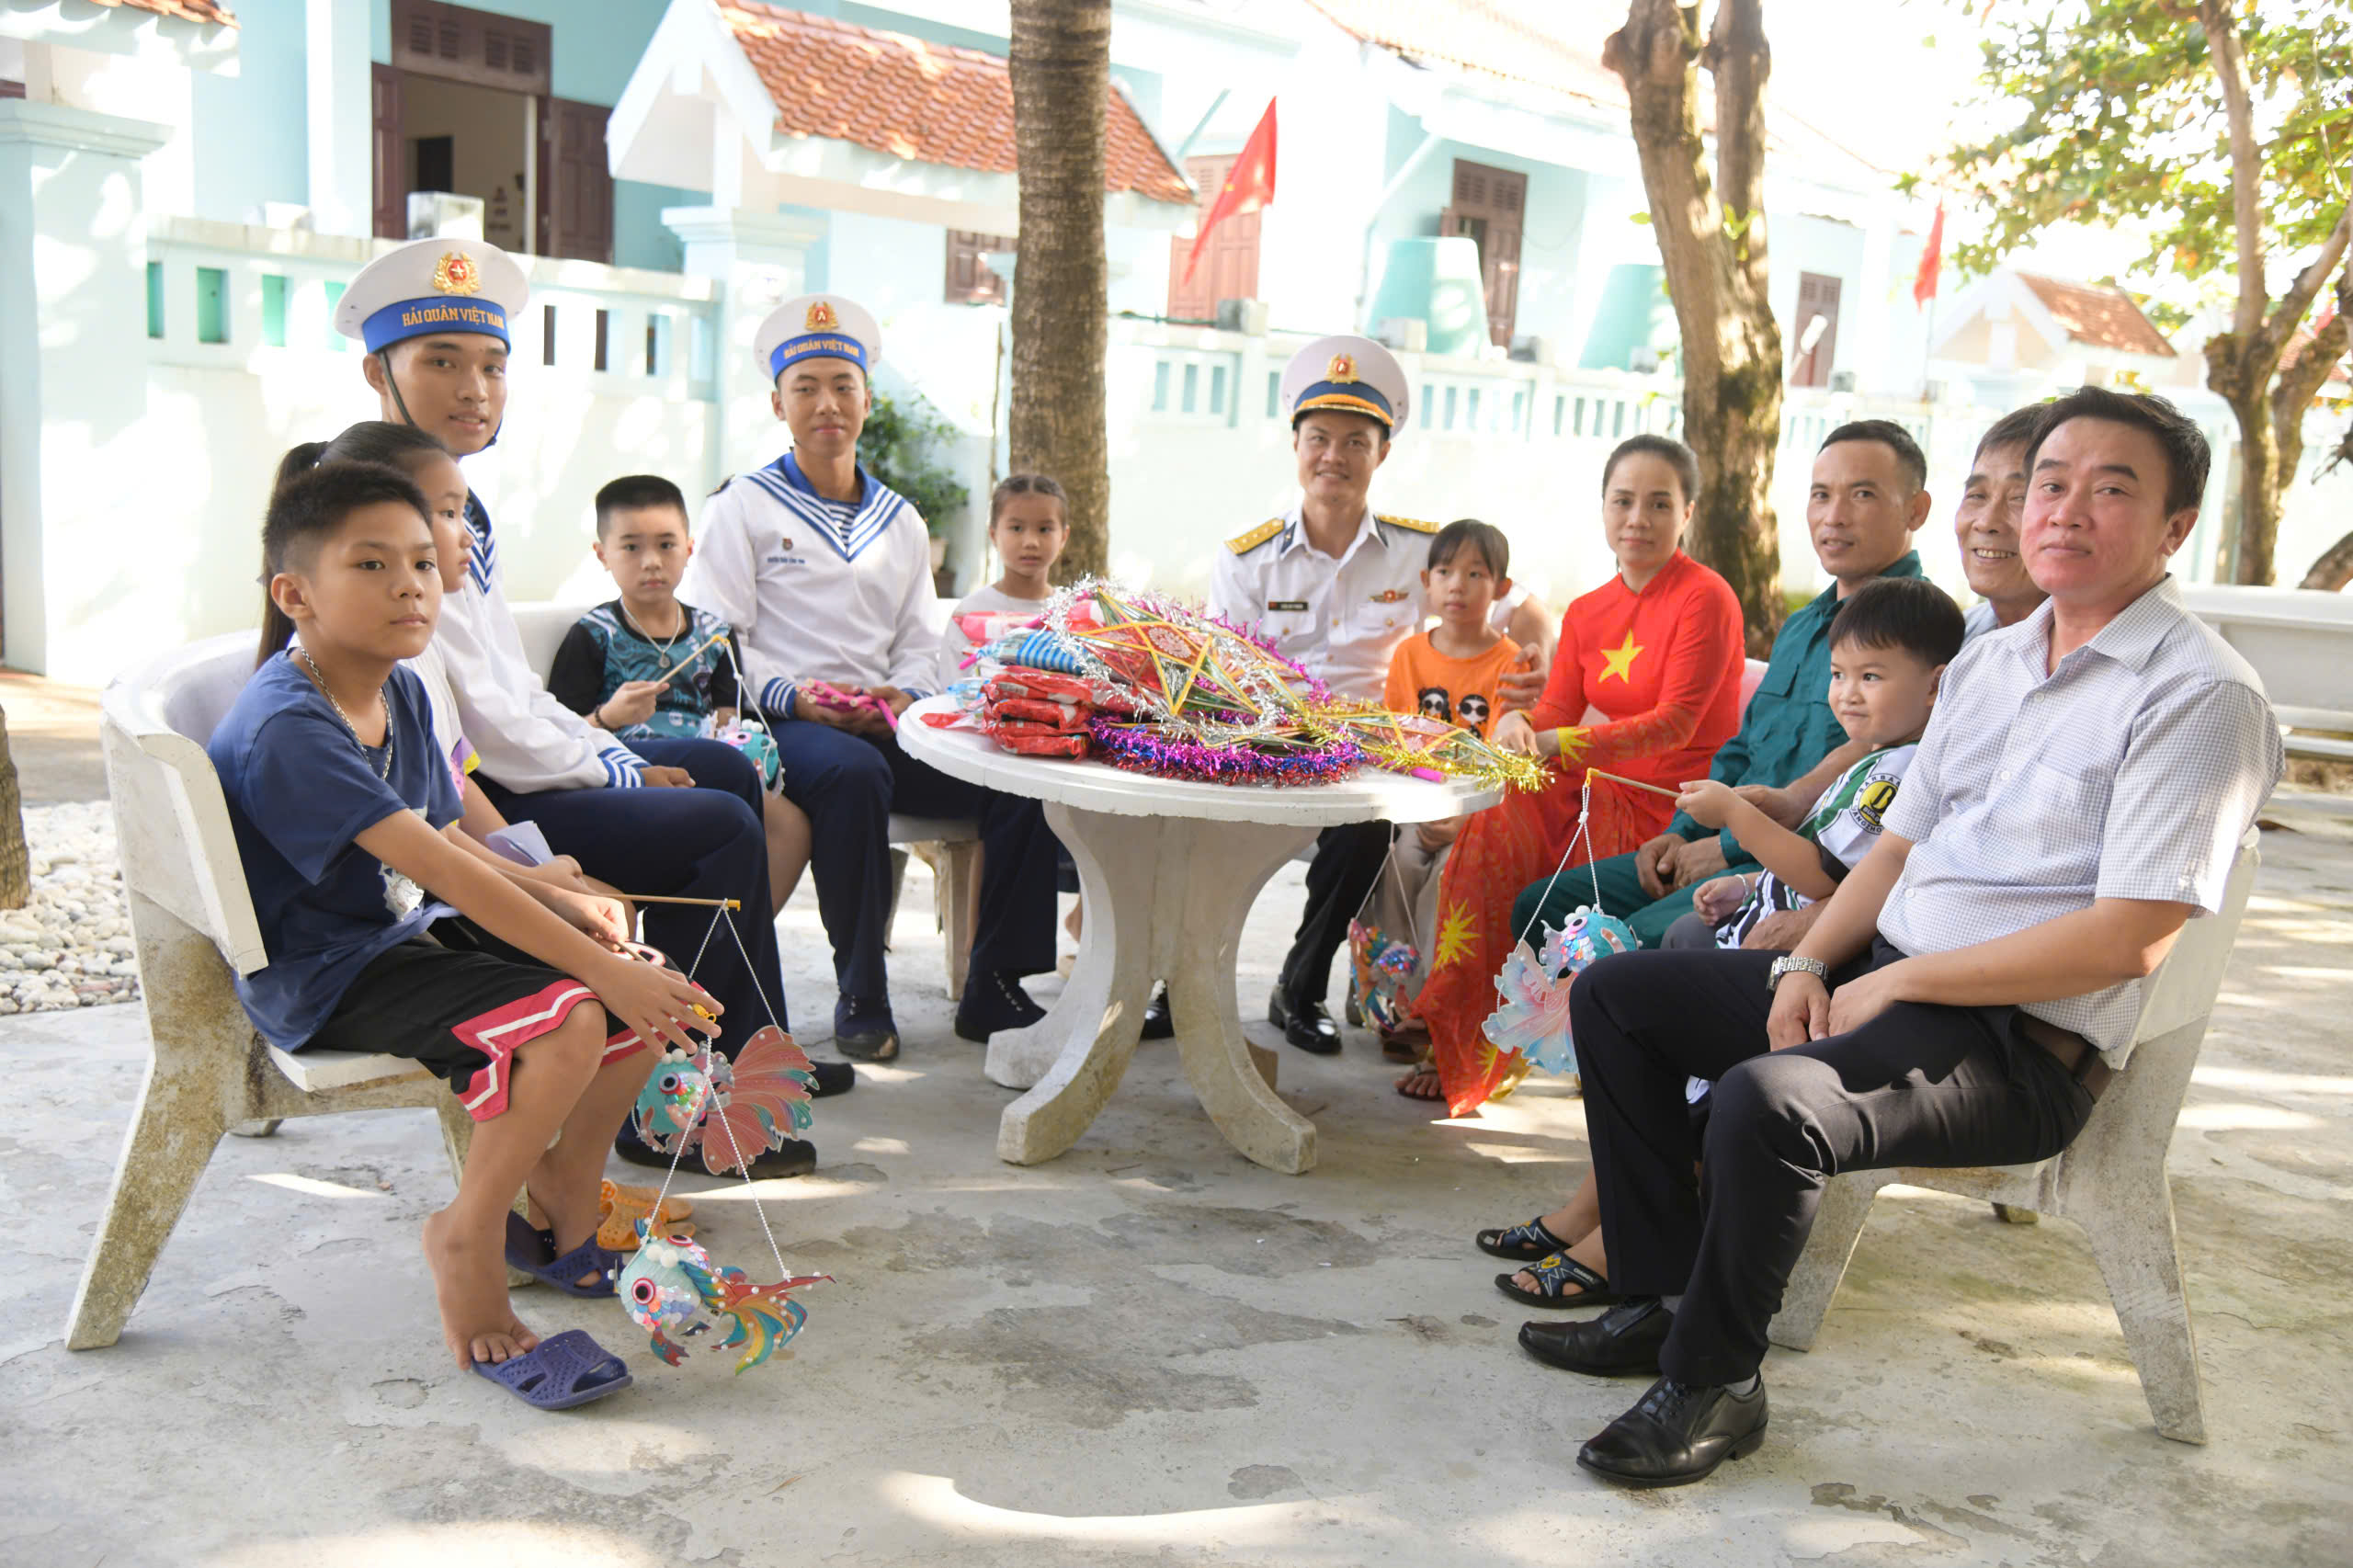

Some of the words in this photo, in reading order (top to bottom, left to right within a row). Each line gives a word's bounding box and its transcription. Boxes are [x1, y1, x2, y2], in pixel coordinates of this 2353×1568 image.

[402, 306, 423, 326] HẢI
[424, 304, 459, 322] QUÂN
[460, 305, 486, 325] VIỆT
[487, 312, 505, 330] NAM
[1852, 805, 1882, 833] ANGZHO
